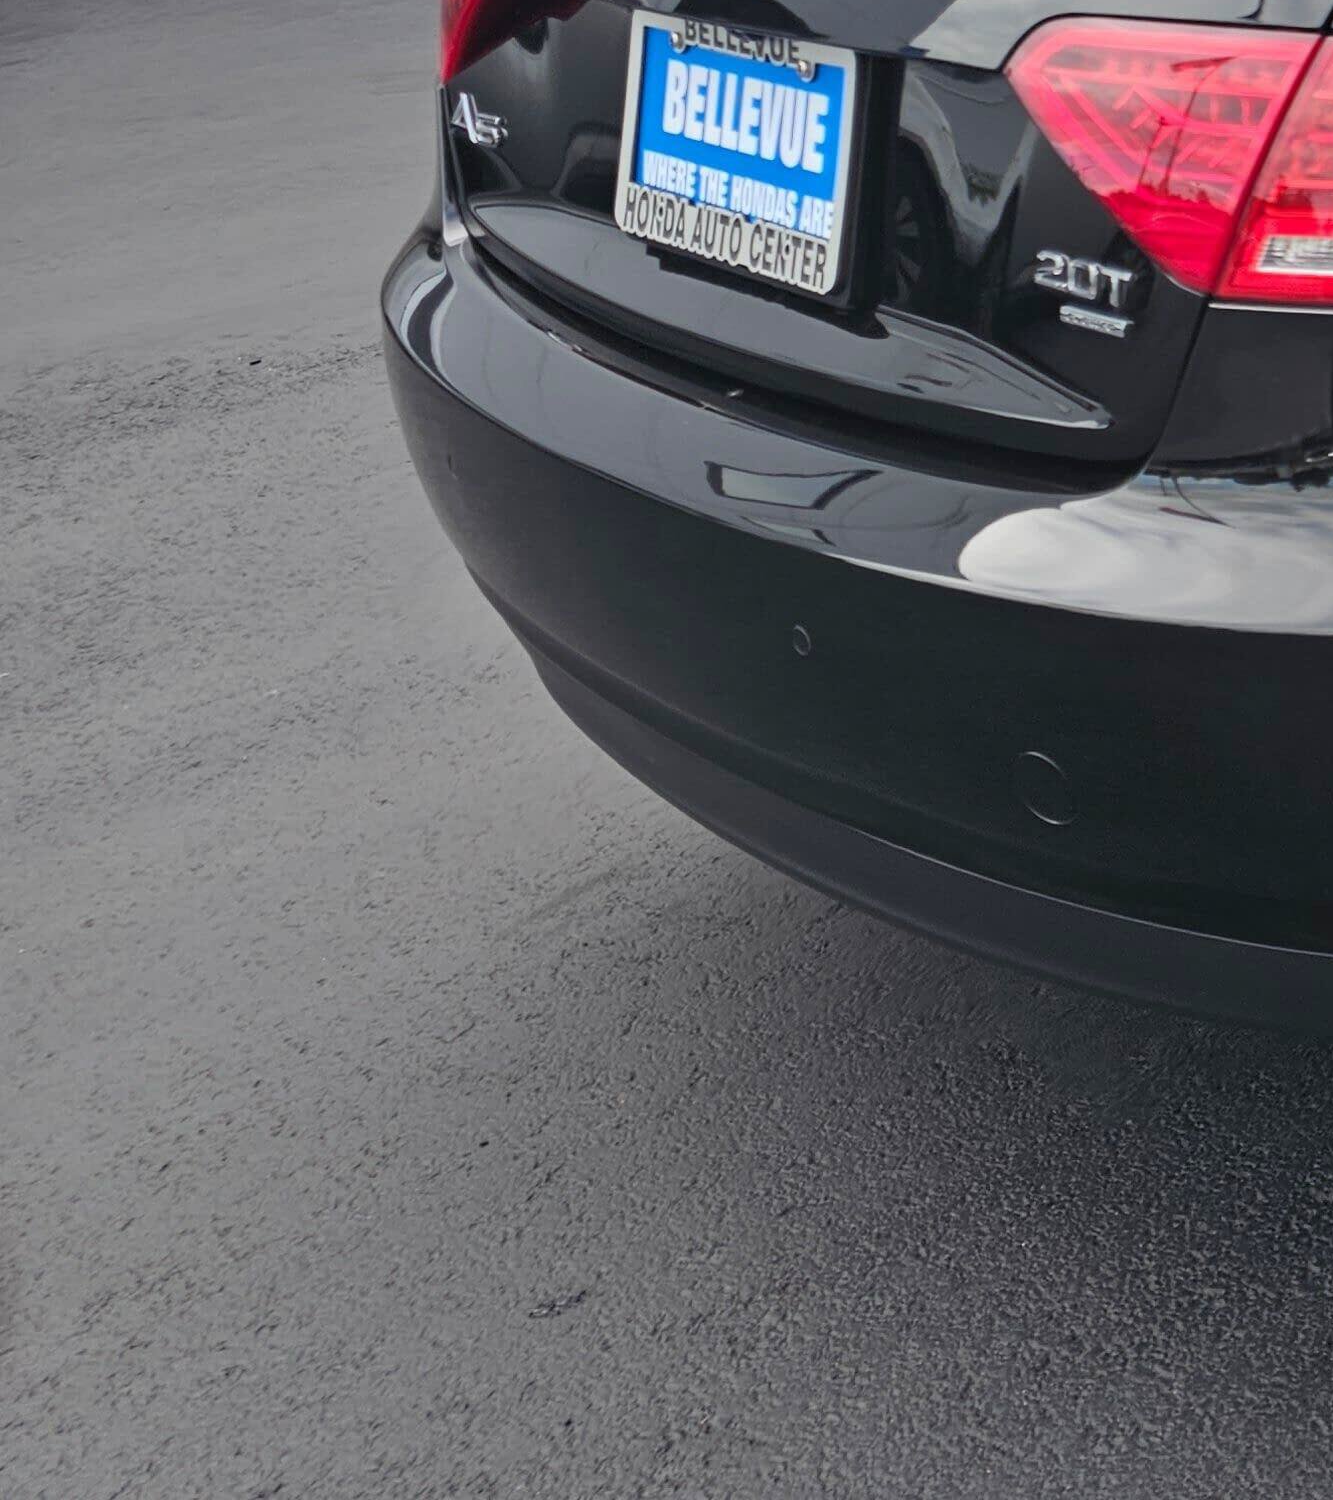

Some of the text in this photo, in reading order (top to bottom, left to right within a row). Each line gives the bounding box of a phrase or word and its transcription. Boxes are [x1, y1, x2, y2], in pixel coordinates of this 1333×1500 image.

[685, 18, 800, 66] BELLEVUE
[662, 58, 829, 174] BELLEVUE
[624, 186, 828, 290] HONDA AUTO CENTER
[642, 148, 835, 240] WHERE THE HONDAS ARE
